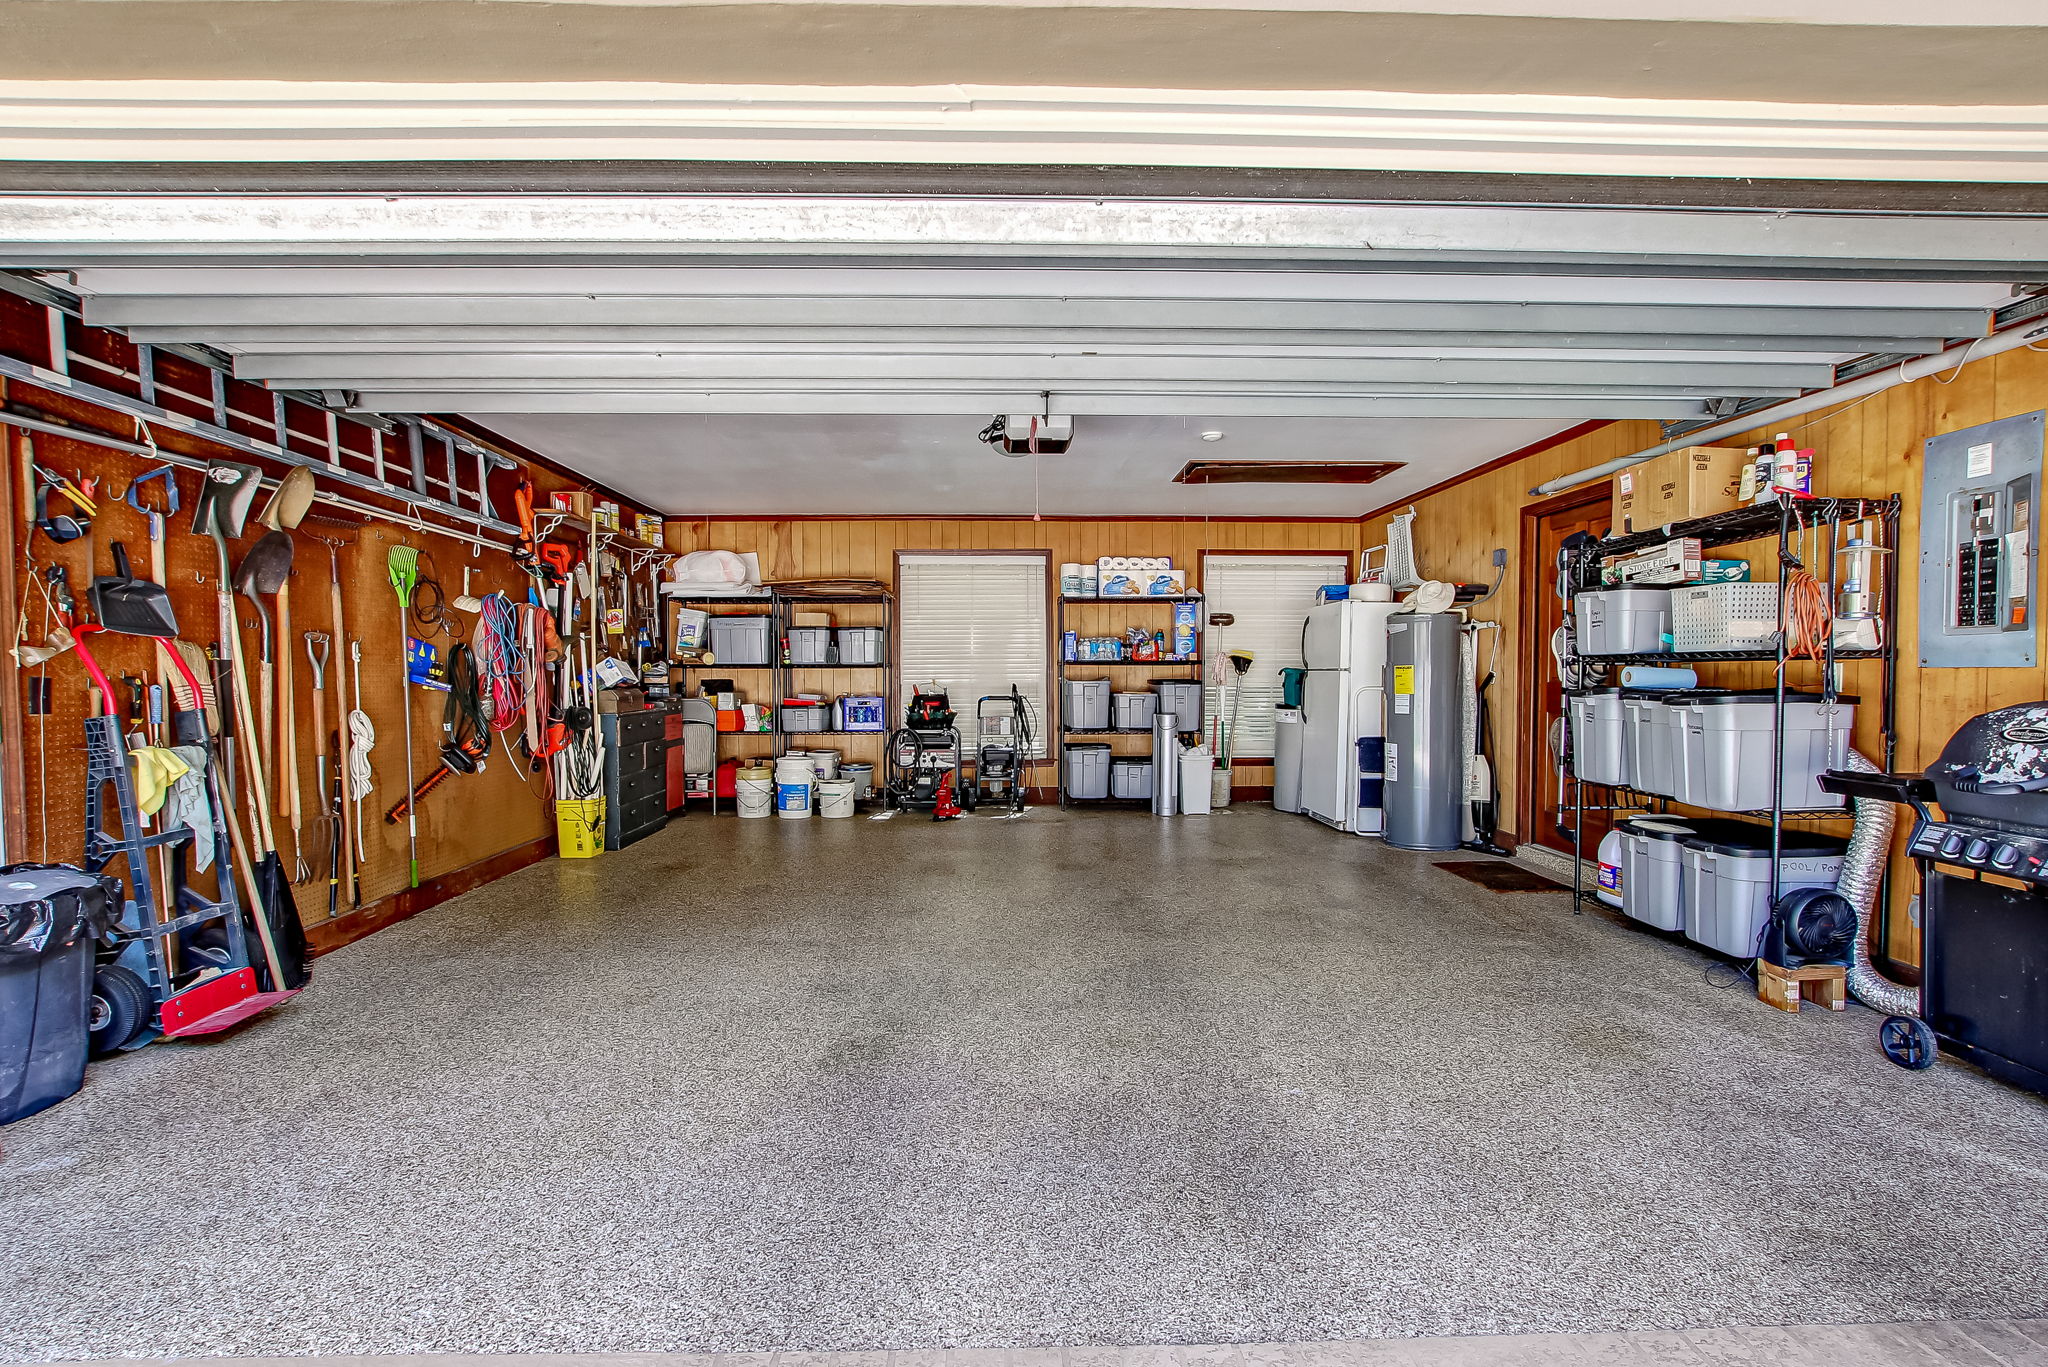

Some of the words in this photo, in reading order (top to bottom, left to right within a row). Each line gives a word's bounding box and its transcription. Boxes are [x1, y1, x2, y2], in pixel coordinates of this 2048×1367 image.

[1628, 560, 1652, 573] STONE
[1653, 556, 1675, 568] EDGE
[1821, 863, 1841, 872] PON
